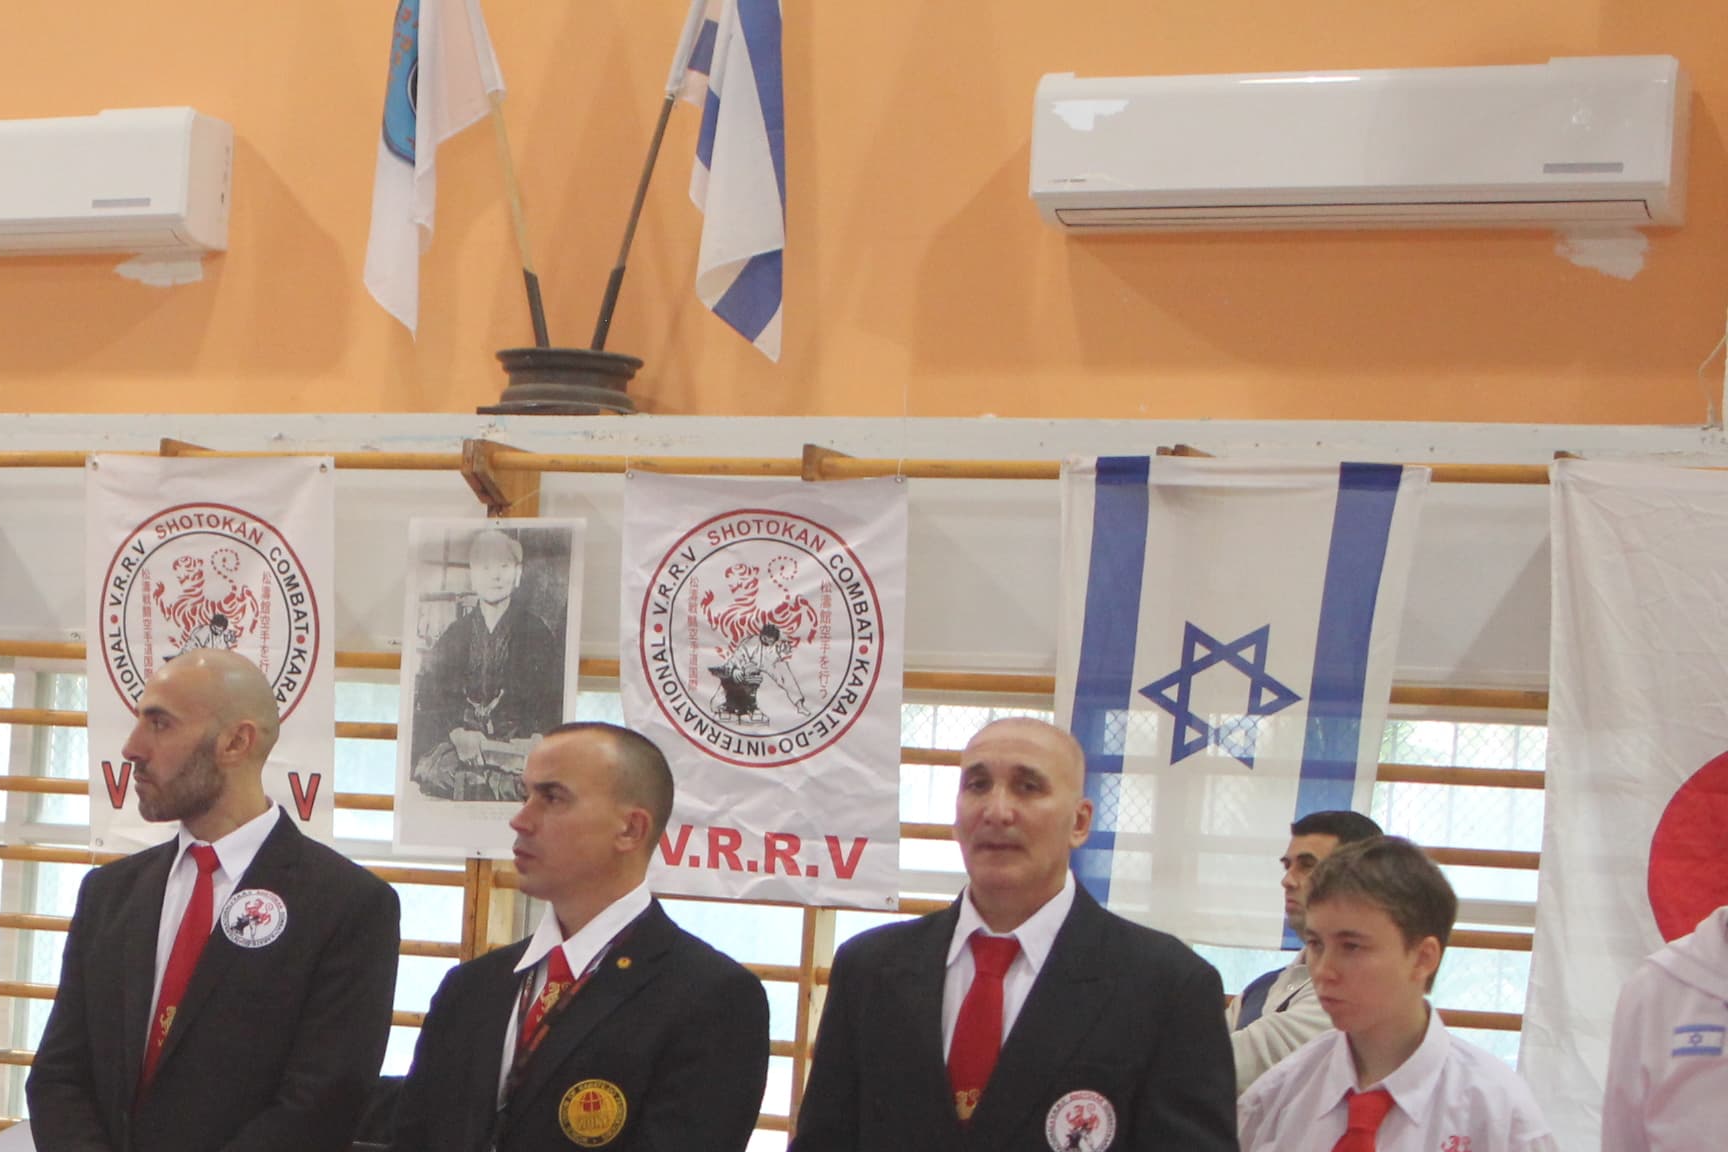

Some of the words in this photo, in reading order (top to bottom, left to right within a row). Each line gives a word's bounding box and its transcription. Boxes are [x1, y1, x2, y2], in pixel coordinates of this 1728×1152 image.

[154, 513, 265, 545] SHOTOKAN
[268, 546, 309, 635] COMBAT
[707, 519, 826, 553] SHOTOKAN
[829, 553, 874, 645] COMBAT
[651, 634, 766, 756] INTERNATIONAL
[779, 658, 870, 754] KARATE-DO
[658, 824, 869, 880] V.R.R.V
